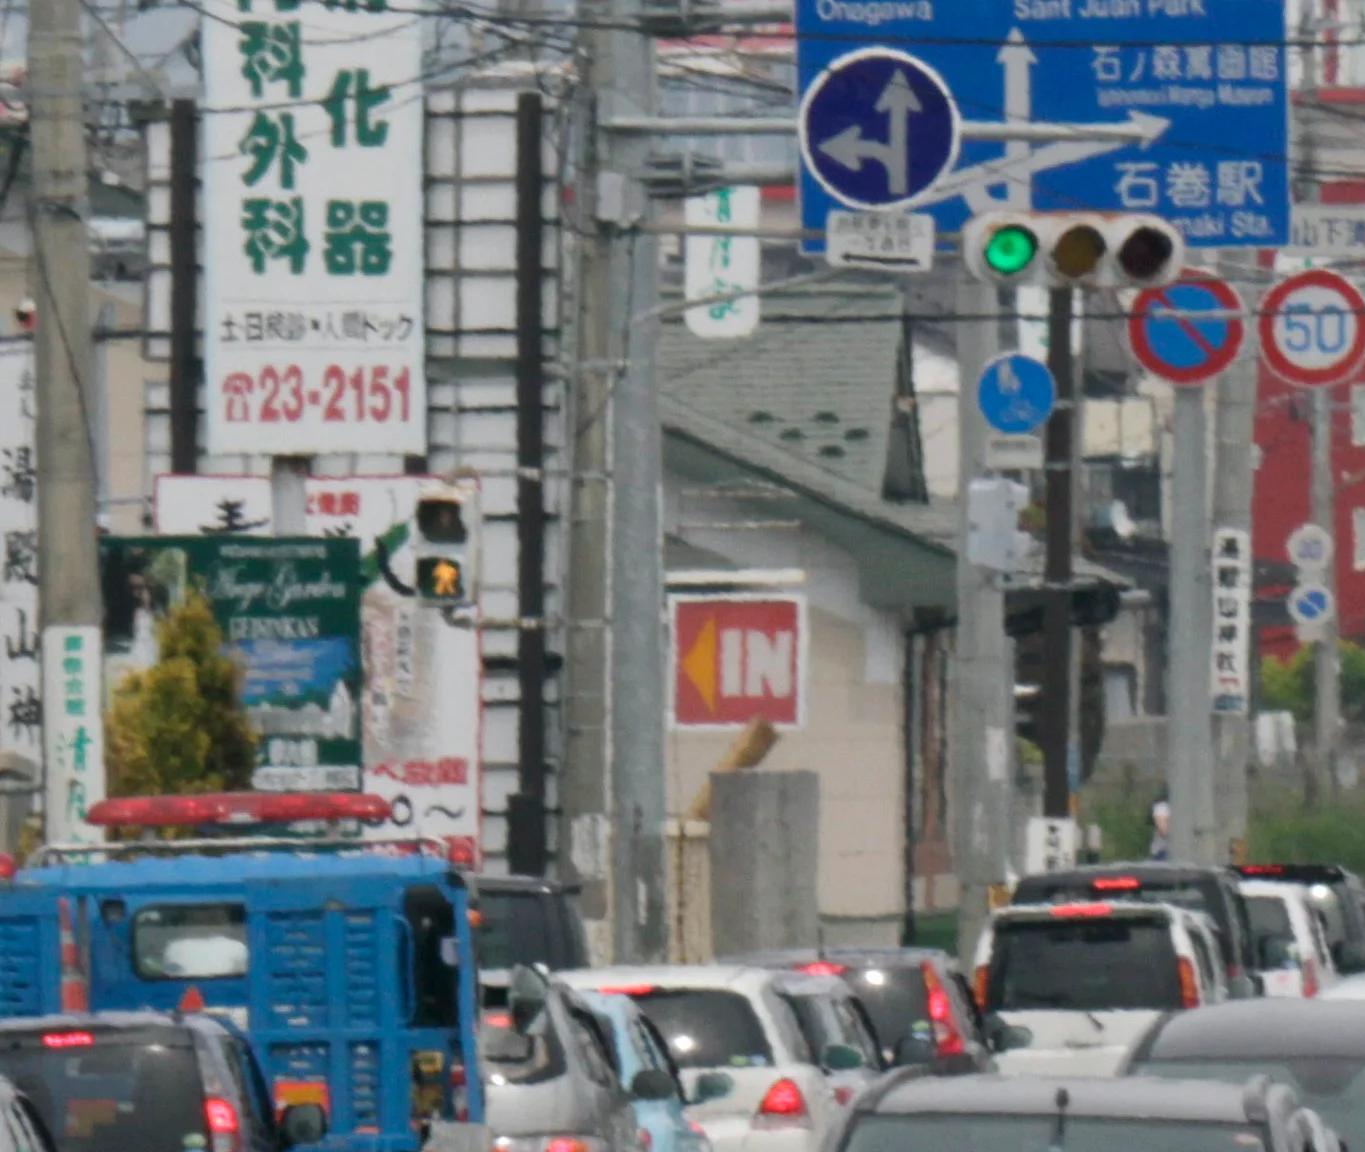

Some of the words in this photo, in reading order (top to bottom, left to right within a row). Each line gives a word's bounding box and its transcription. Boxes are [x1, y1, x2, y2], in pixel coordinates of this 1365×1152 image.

[238, 0, 310, 275] 科外科
[1113, 161, 1264, 208] 石巻駅
[1284, 304, 1346, 354] 50
[258, 363, 412, 424] 23-2151
[721, 628, 793, 699] IN
